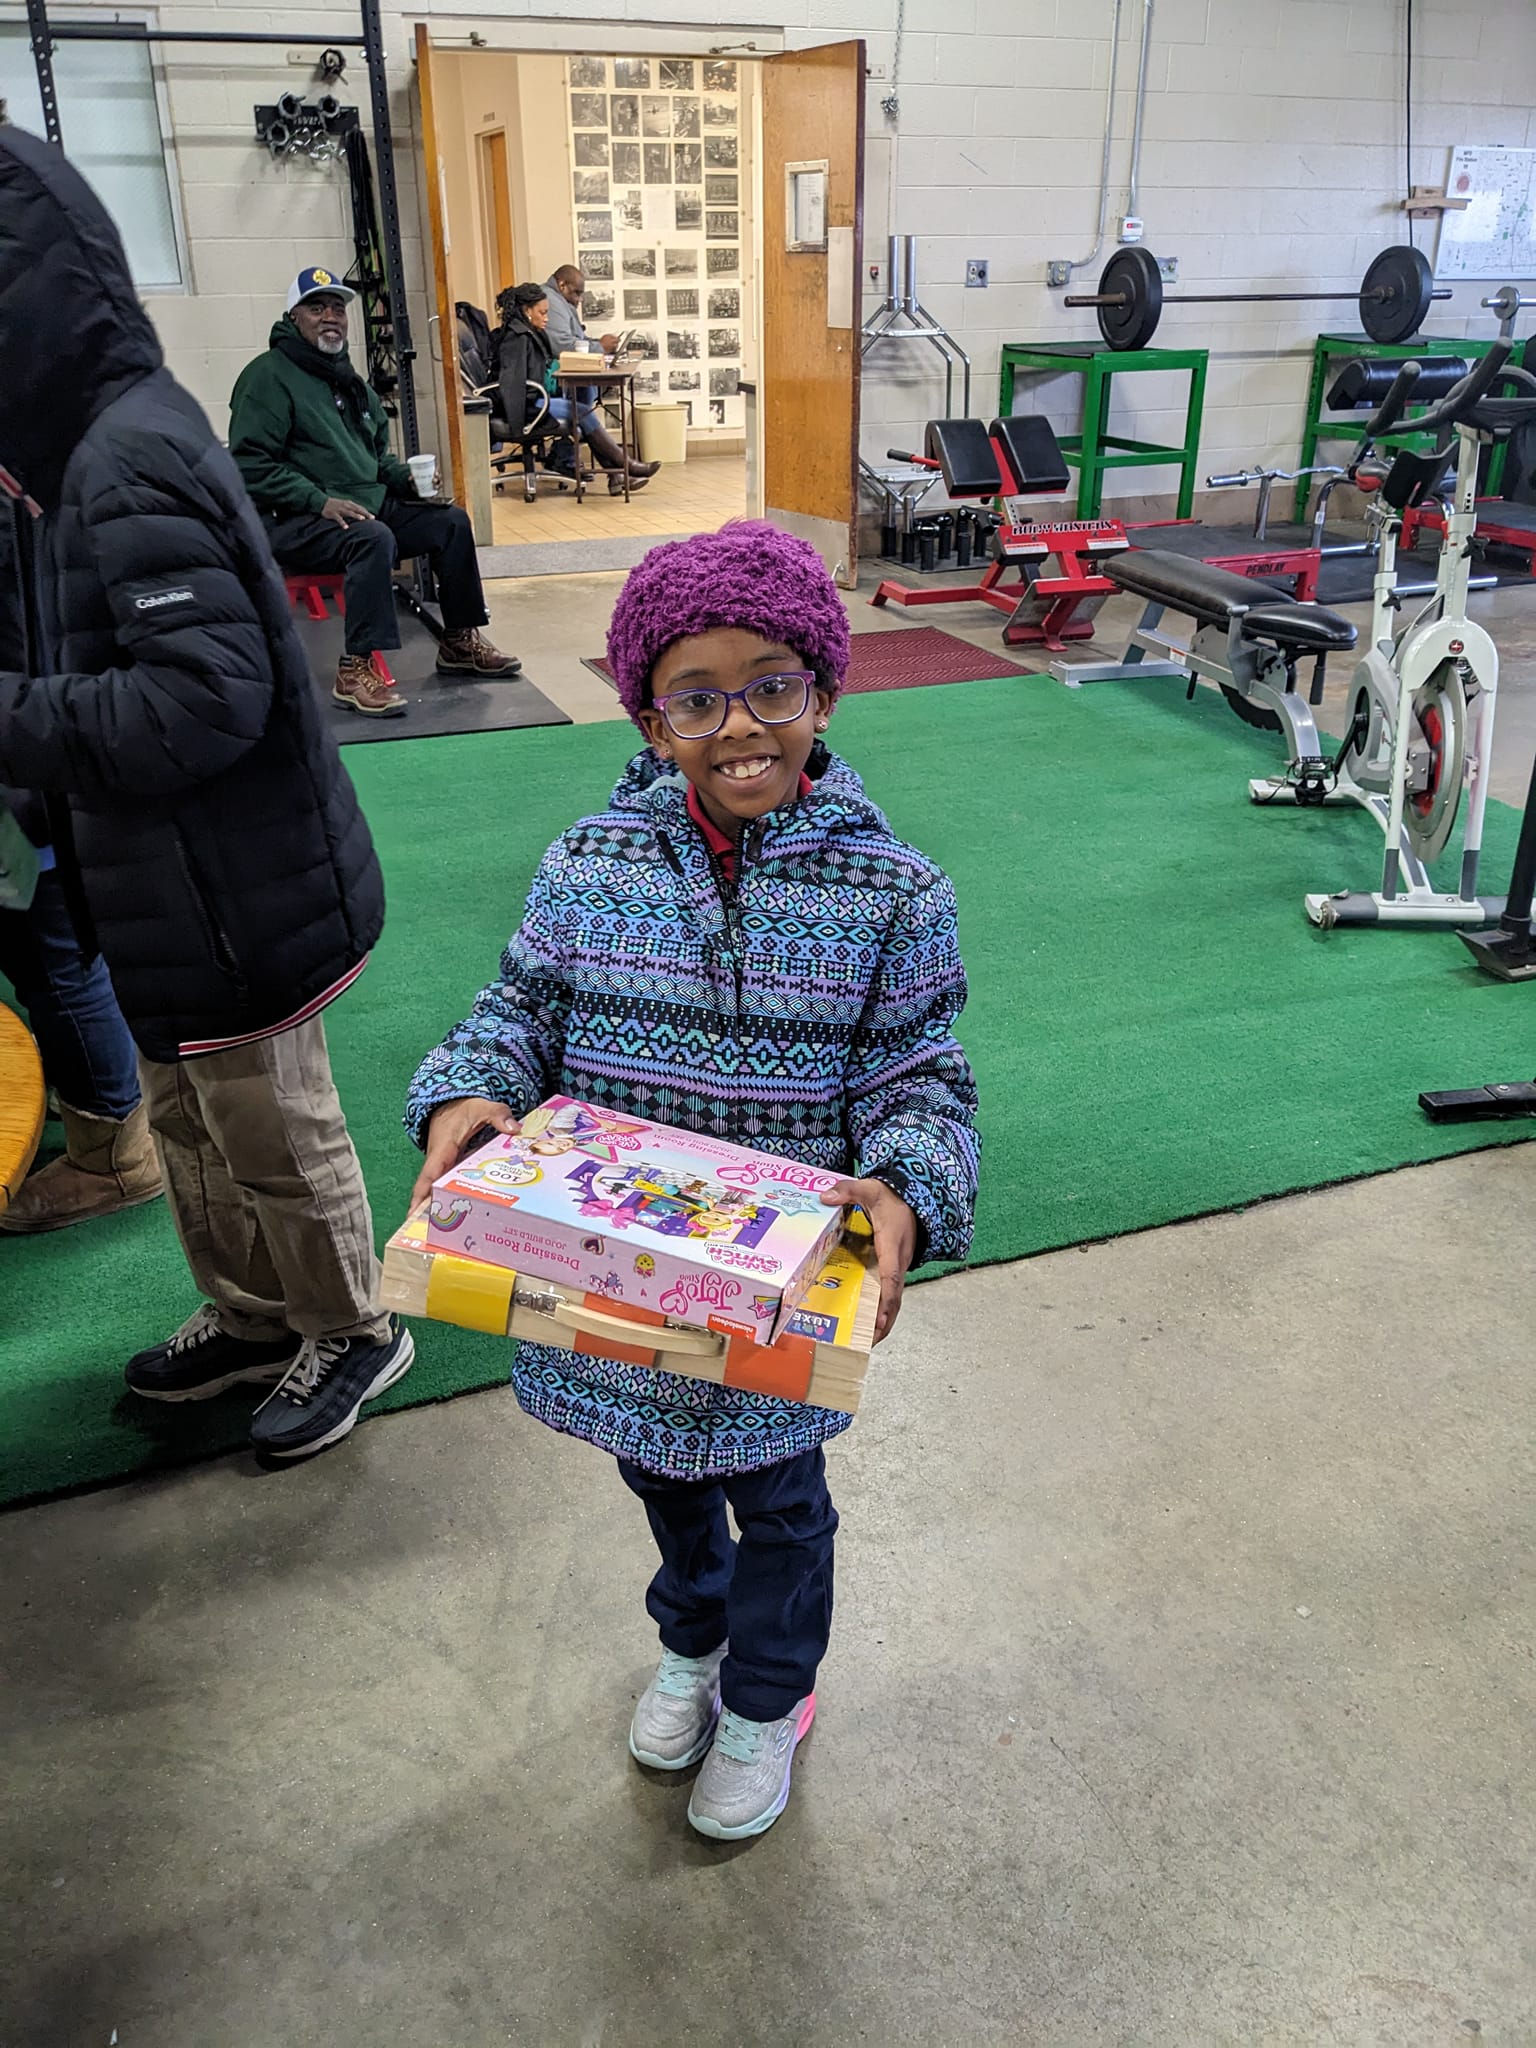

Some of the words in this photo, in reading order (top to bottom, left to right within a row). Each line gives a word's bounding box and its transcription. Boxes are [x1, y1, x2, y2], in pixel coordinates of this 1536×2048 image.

[1246, 562, 1286, 576] PENDLAY
[688, 1142, 740, 1161] Dressing
[489, 1170, 521, 1182] 100
[455, 1180, 514, 1200] nickelodeon
[503, 1226, 518, 1236] SET
[520, 1230, 544, 1244] BUILD
[484, 1233, 521, 1253] Room
[544, 1237, 567, 1250] JOJO
[524, 1241, 581, 1271] Dressing
[709, 1247, 779, 1268] SWITCH
[724, 1258, 773, 1273] SNAP
[710, 1315, 754, 1334] nickelodeon
[792, 1311, 831, 1328] LUXE
